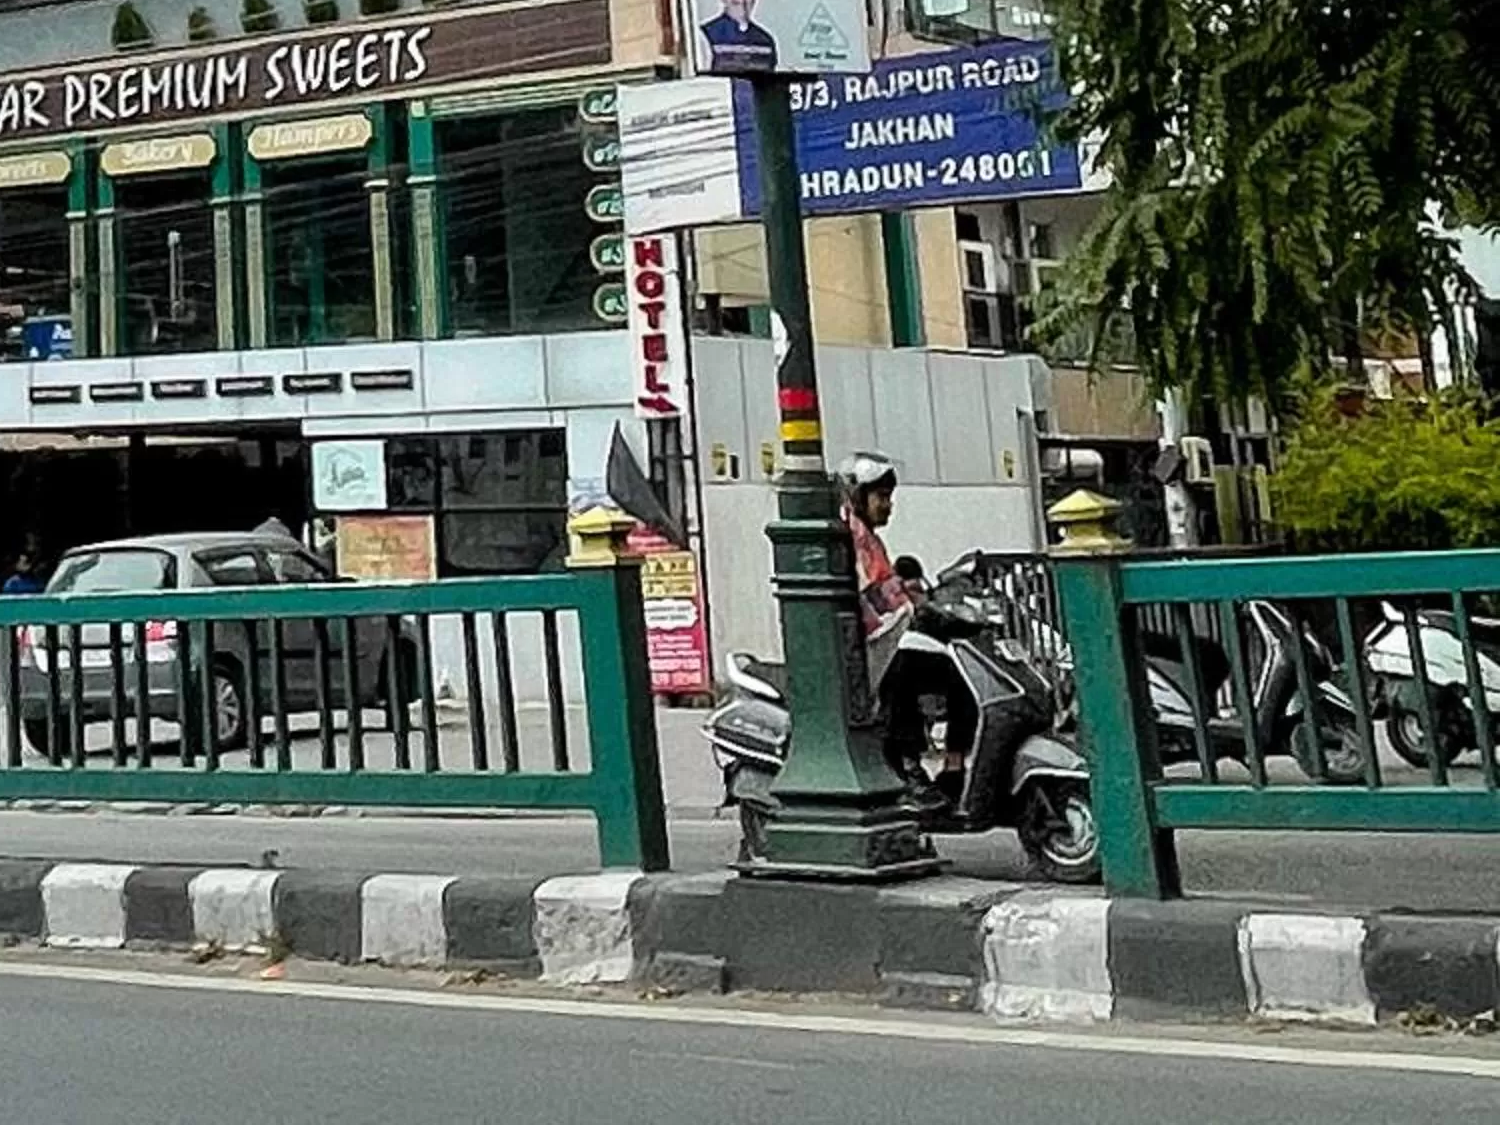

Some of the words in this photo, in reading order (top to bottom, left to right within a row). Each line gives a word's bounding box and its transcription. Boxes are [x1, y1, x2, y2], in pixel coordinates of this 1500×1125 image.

[64, 55, 250, 127] PREMIUM
[265, 27, 434, 100] SWEETS
[845, 65, 955, 103] RAJPUR
[962, 54, 1040, 89] ROAD
[844, 112, 955, 150] JAKHAN
[799, 149, 1052, 198] HRADUN-248001
[634, 238, 671, 393] HOTEL
